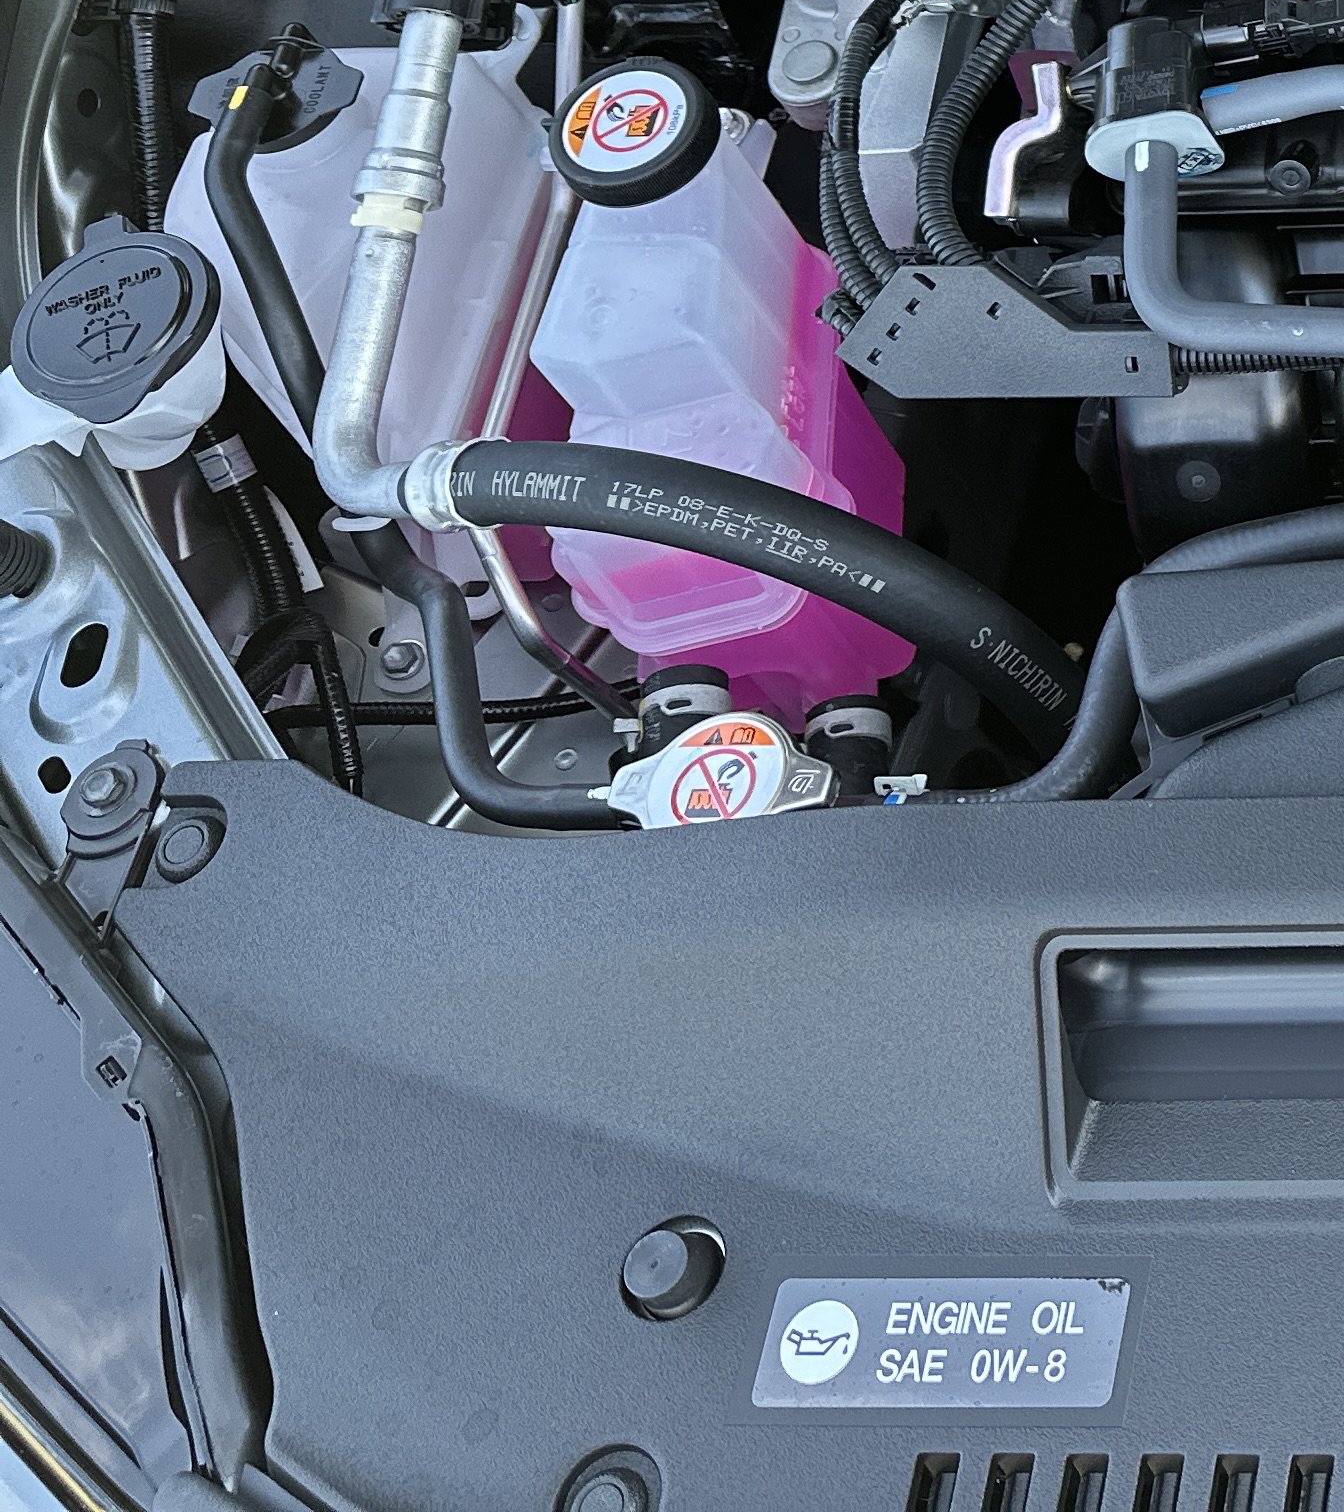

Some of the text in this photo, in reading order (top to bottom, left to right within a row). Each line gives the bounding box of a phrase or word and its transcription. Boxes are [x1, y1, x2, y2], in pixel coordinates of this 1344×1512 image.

[303, 65, 332, 114] COOLANT
[45, 266, 162, 316] WASHER FLUID
[84, 291, 124, 315] ONLY
[491, 470, 587, 503] HYLAMMIT
[612, 481, 664, 500] 17LP
[885, 1301, 1085, 1335] ENGINE OIL
[876, 1349, 1067, 1383] SAE 0W-8
